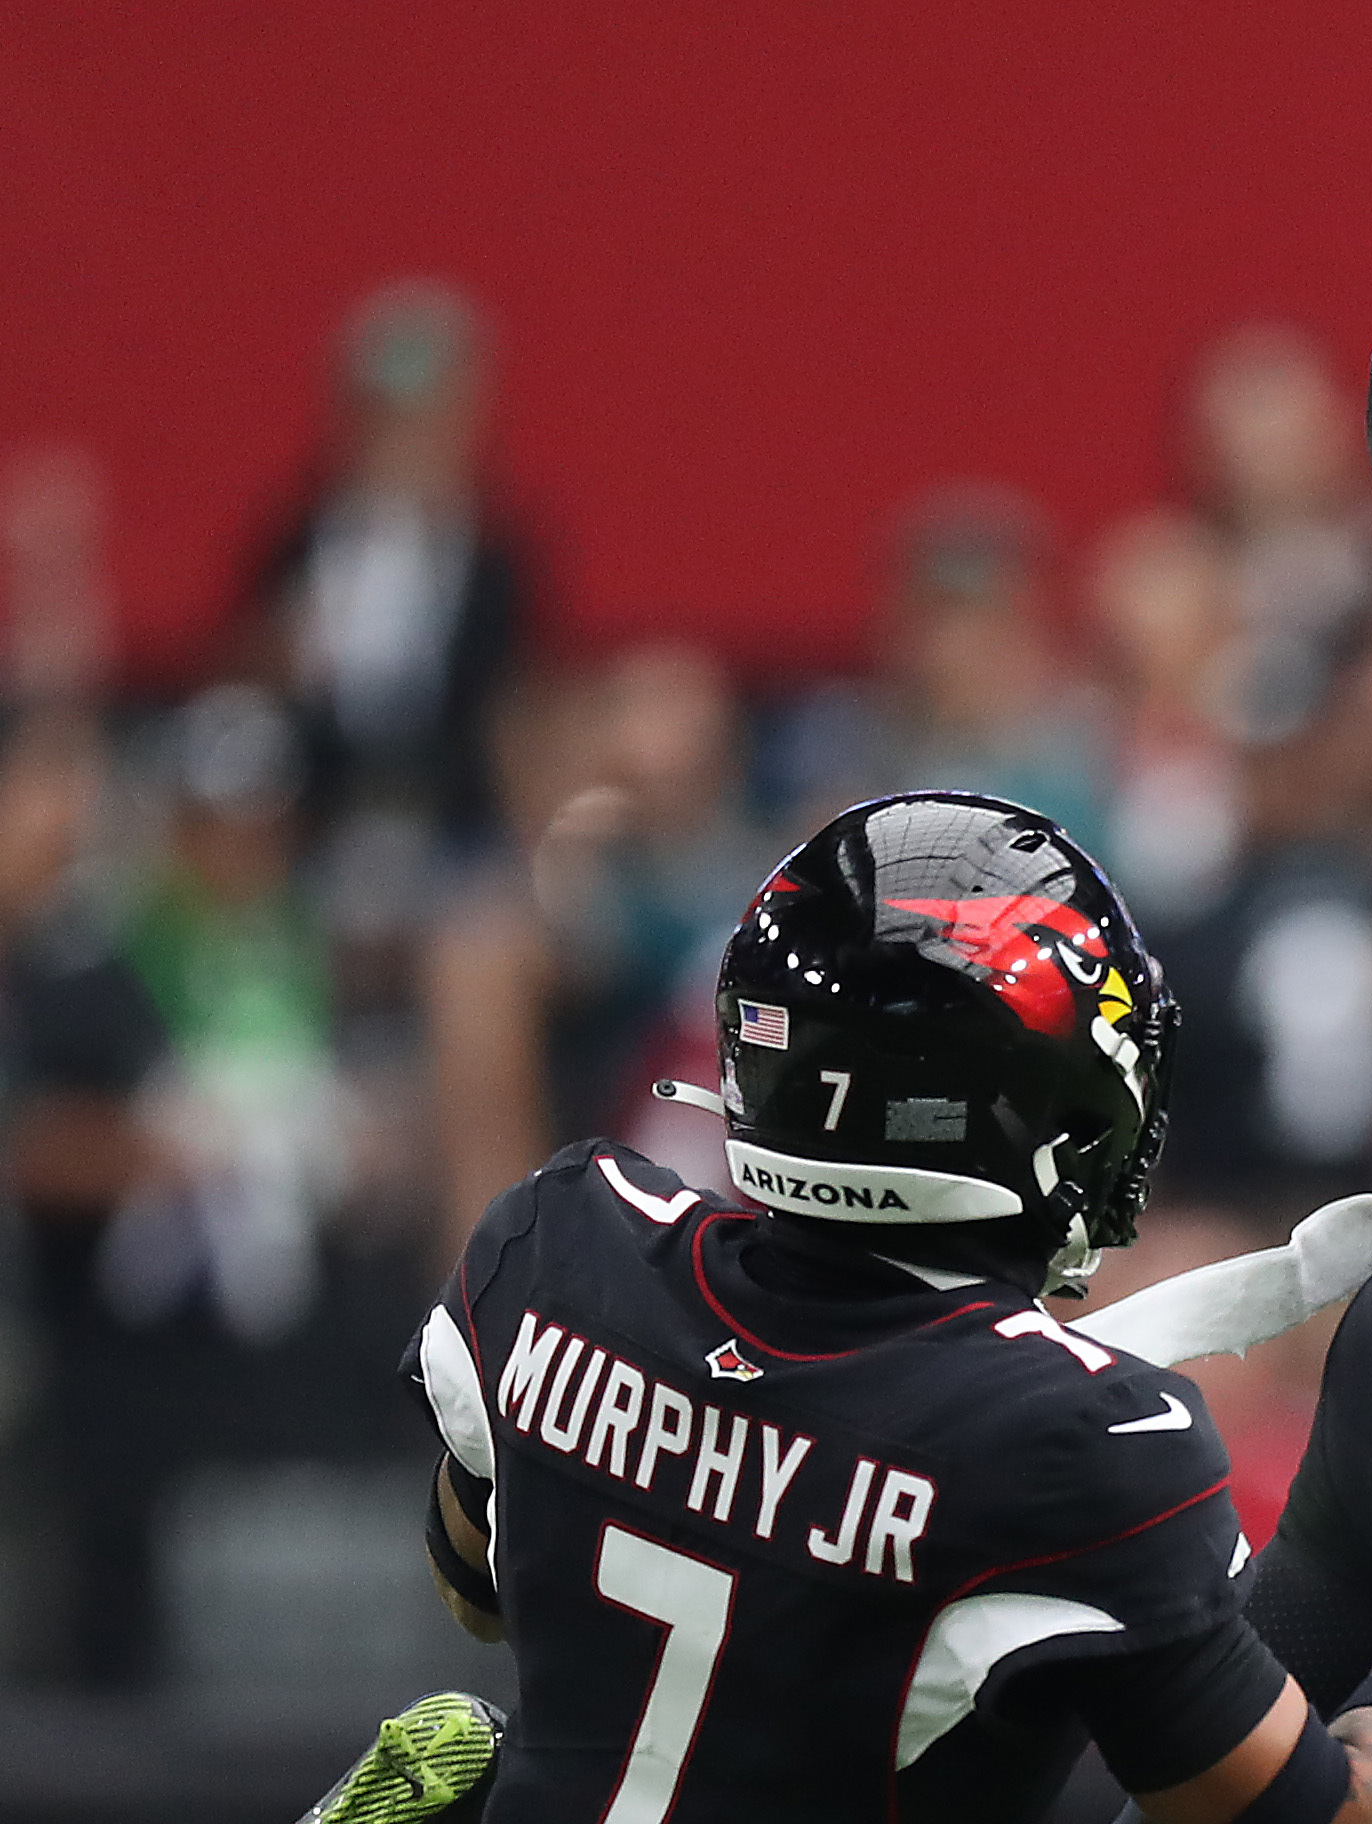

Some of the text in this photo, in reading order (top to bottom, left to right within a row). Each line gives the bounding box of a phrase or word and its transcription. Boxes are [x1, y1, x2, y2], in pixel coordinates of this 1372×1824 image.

[819, 1069, 851, 1131] 7
[742, 1162, 911, 1211] ARIZONA
[498, 1310, 938, 1585] MURPHY JR
